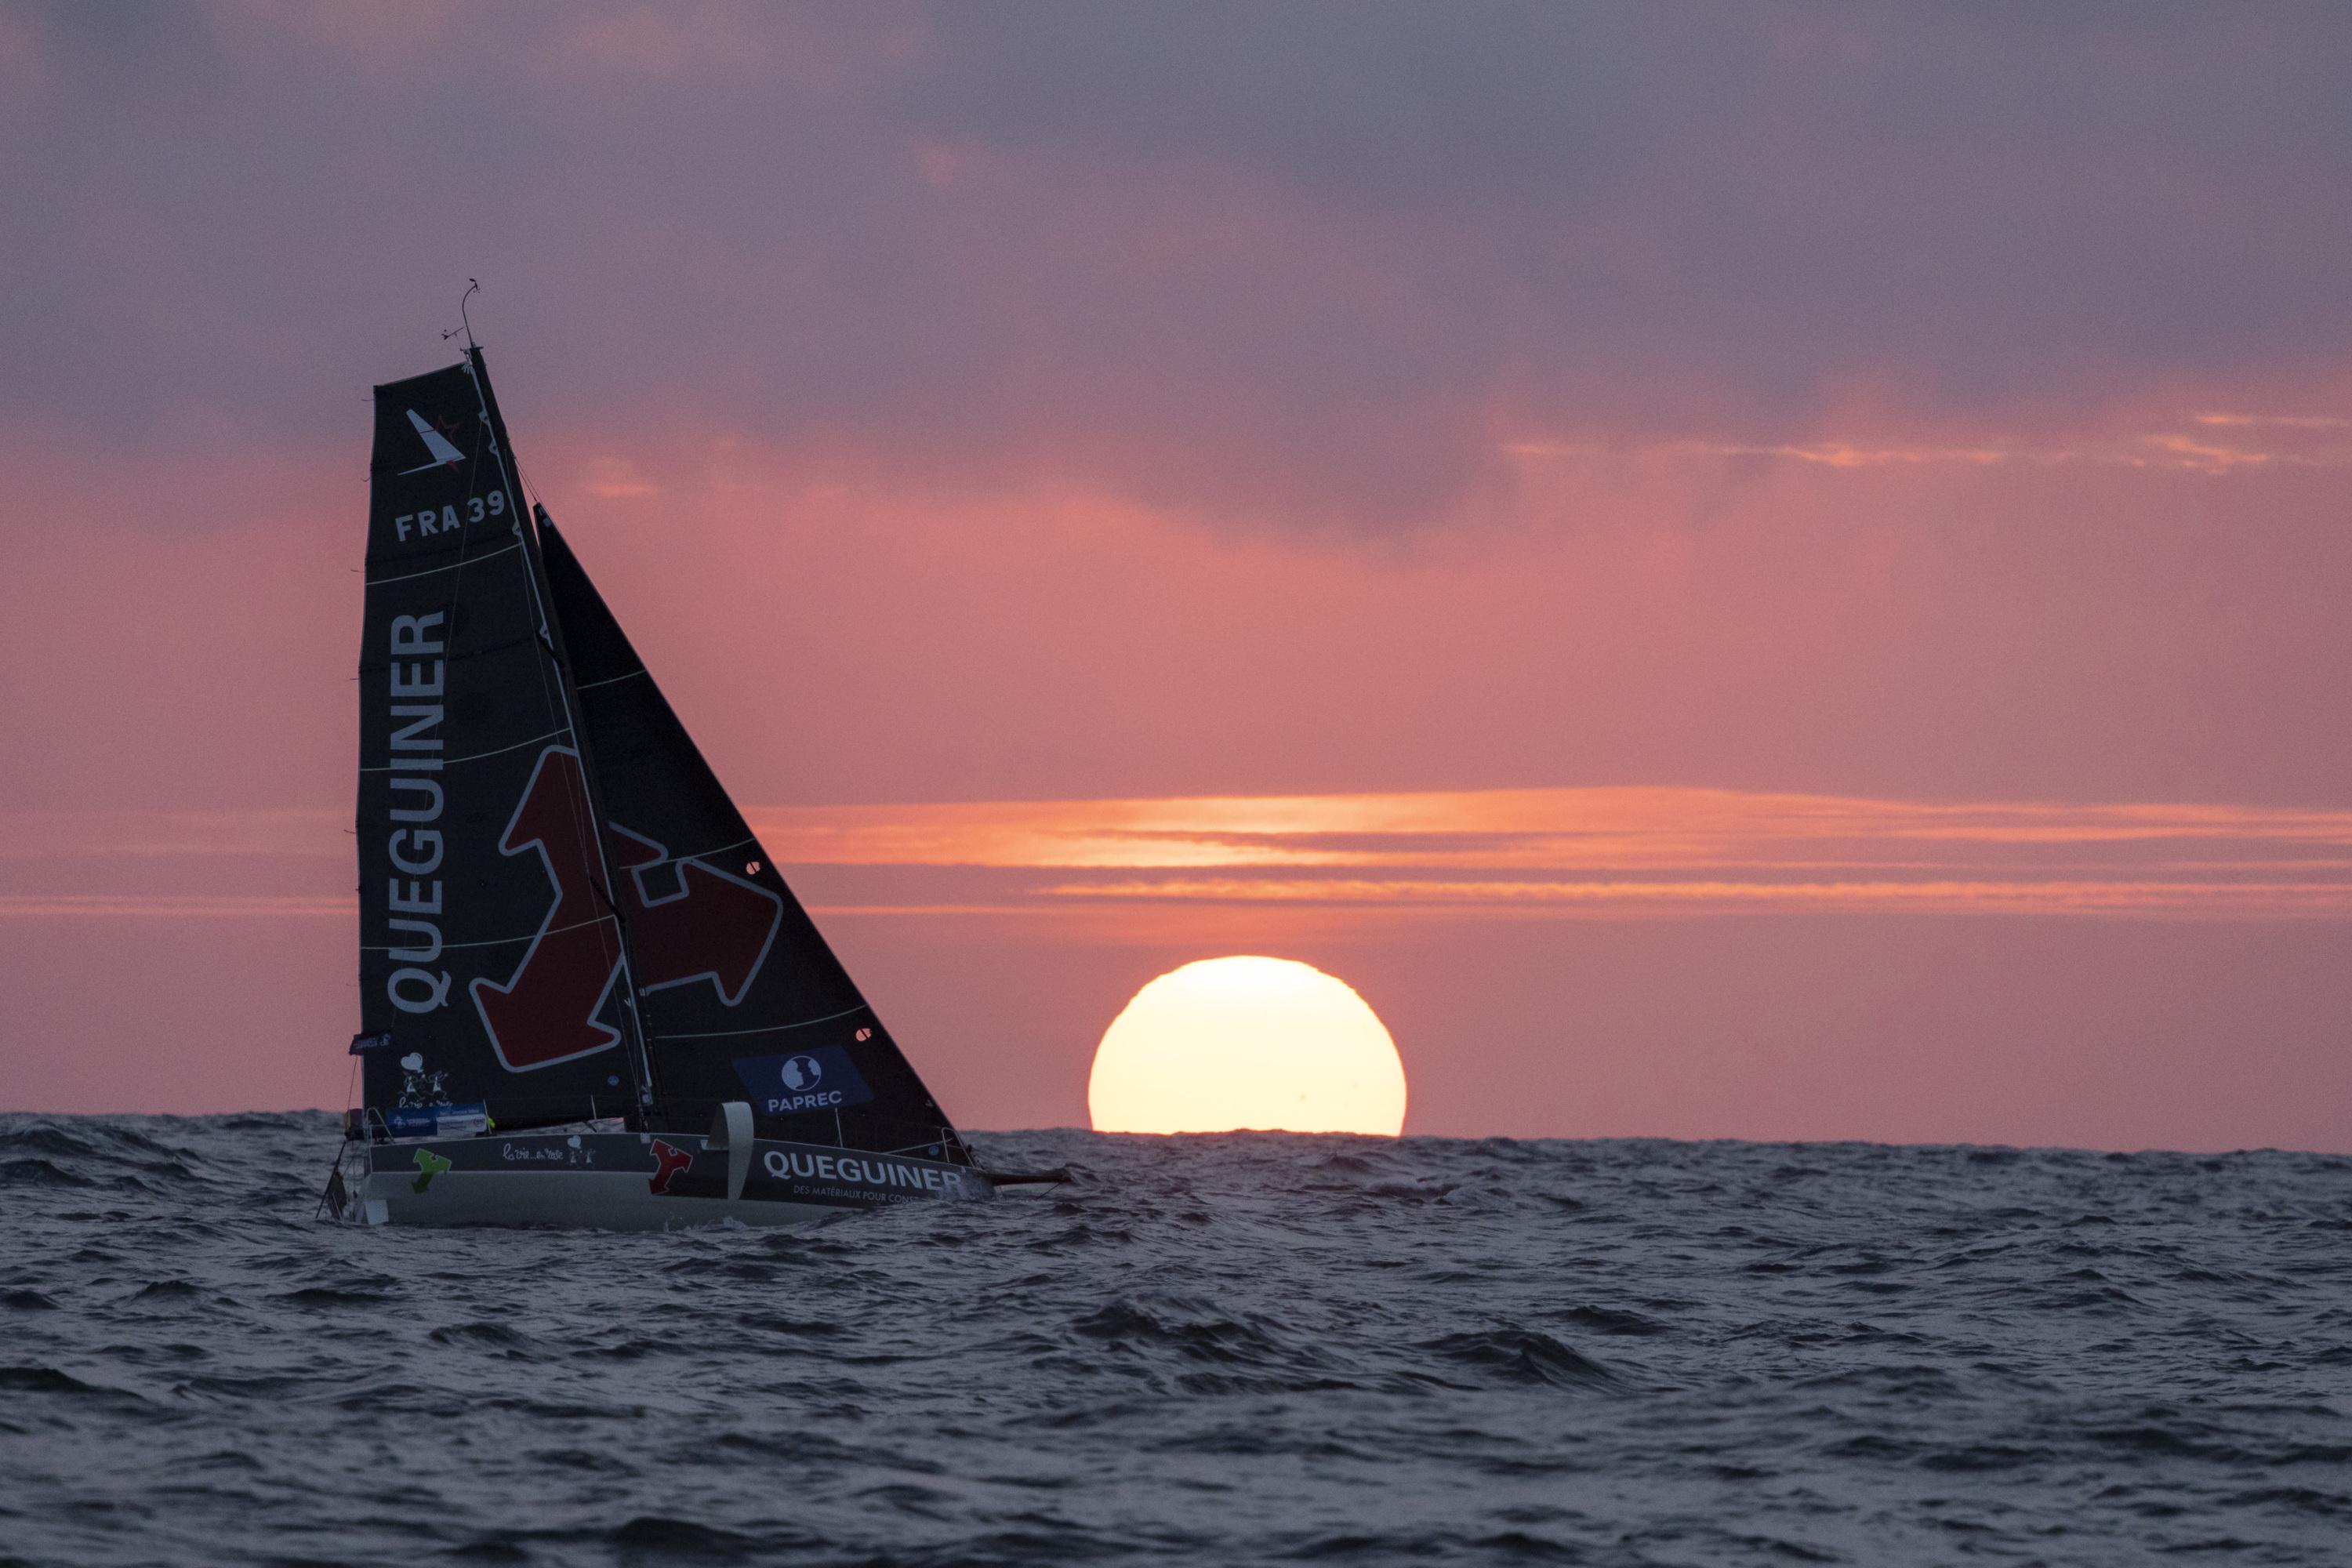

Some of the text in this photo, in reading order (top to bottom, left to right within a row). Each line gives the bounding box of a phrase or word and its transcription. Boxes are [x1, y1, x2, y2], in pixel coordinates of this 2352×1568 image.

[394, 490, 505, 542] FRA 39
[387, 610, 452, 1014] QUEGUINER
[768, 1091, 842, 1112] PAPREC
[764, 1150, 966, 1192] QUEGUINER
[793, 1185, 810, 1195] DES
[811, 1185, 861, 1200] MATÉRIAUX
[862, 1191, 887, 1202] POUR
